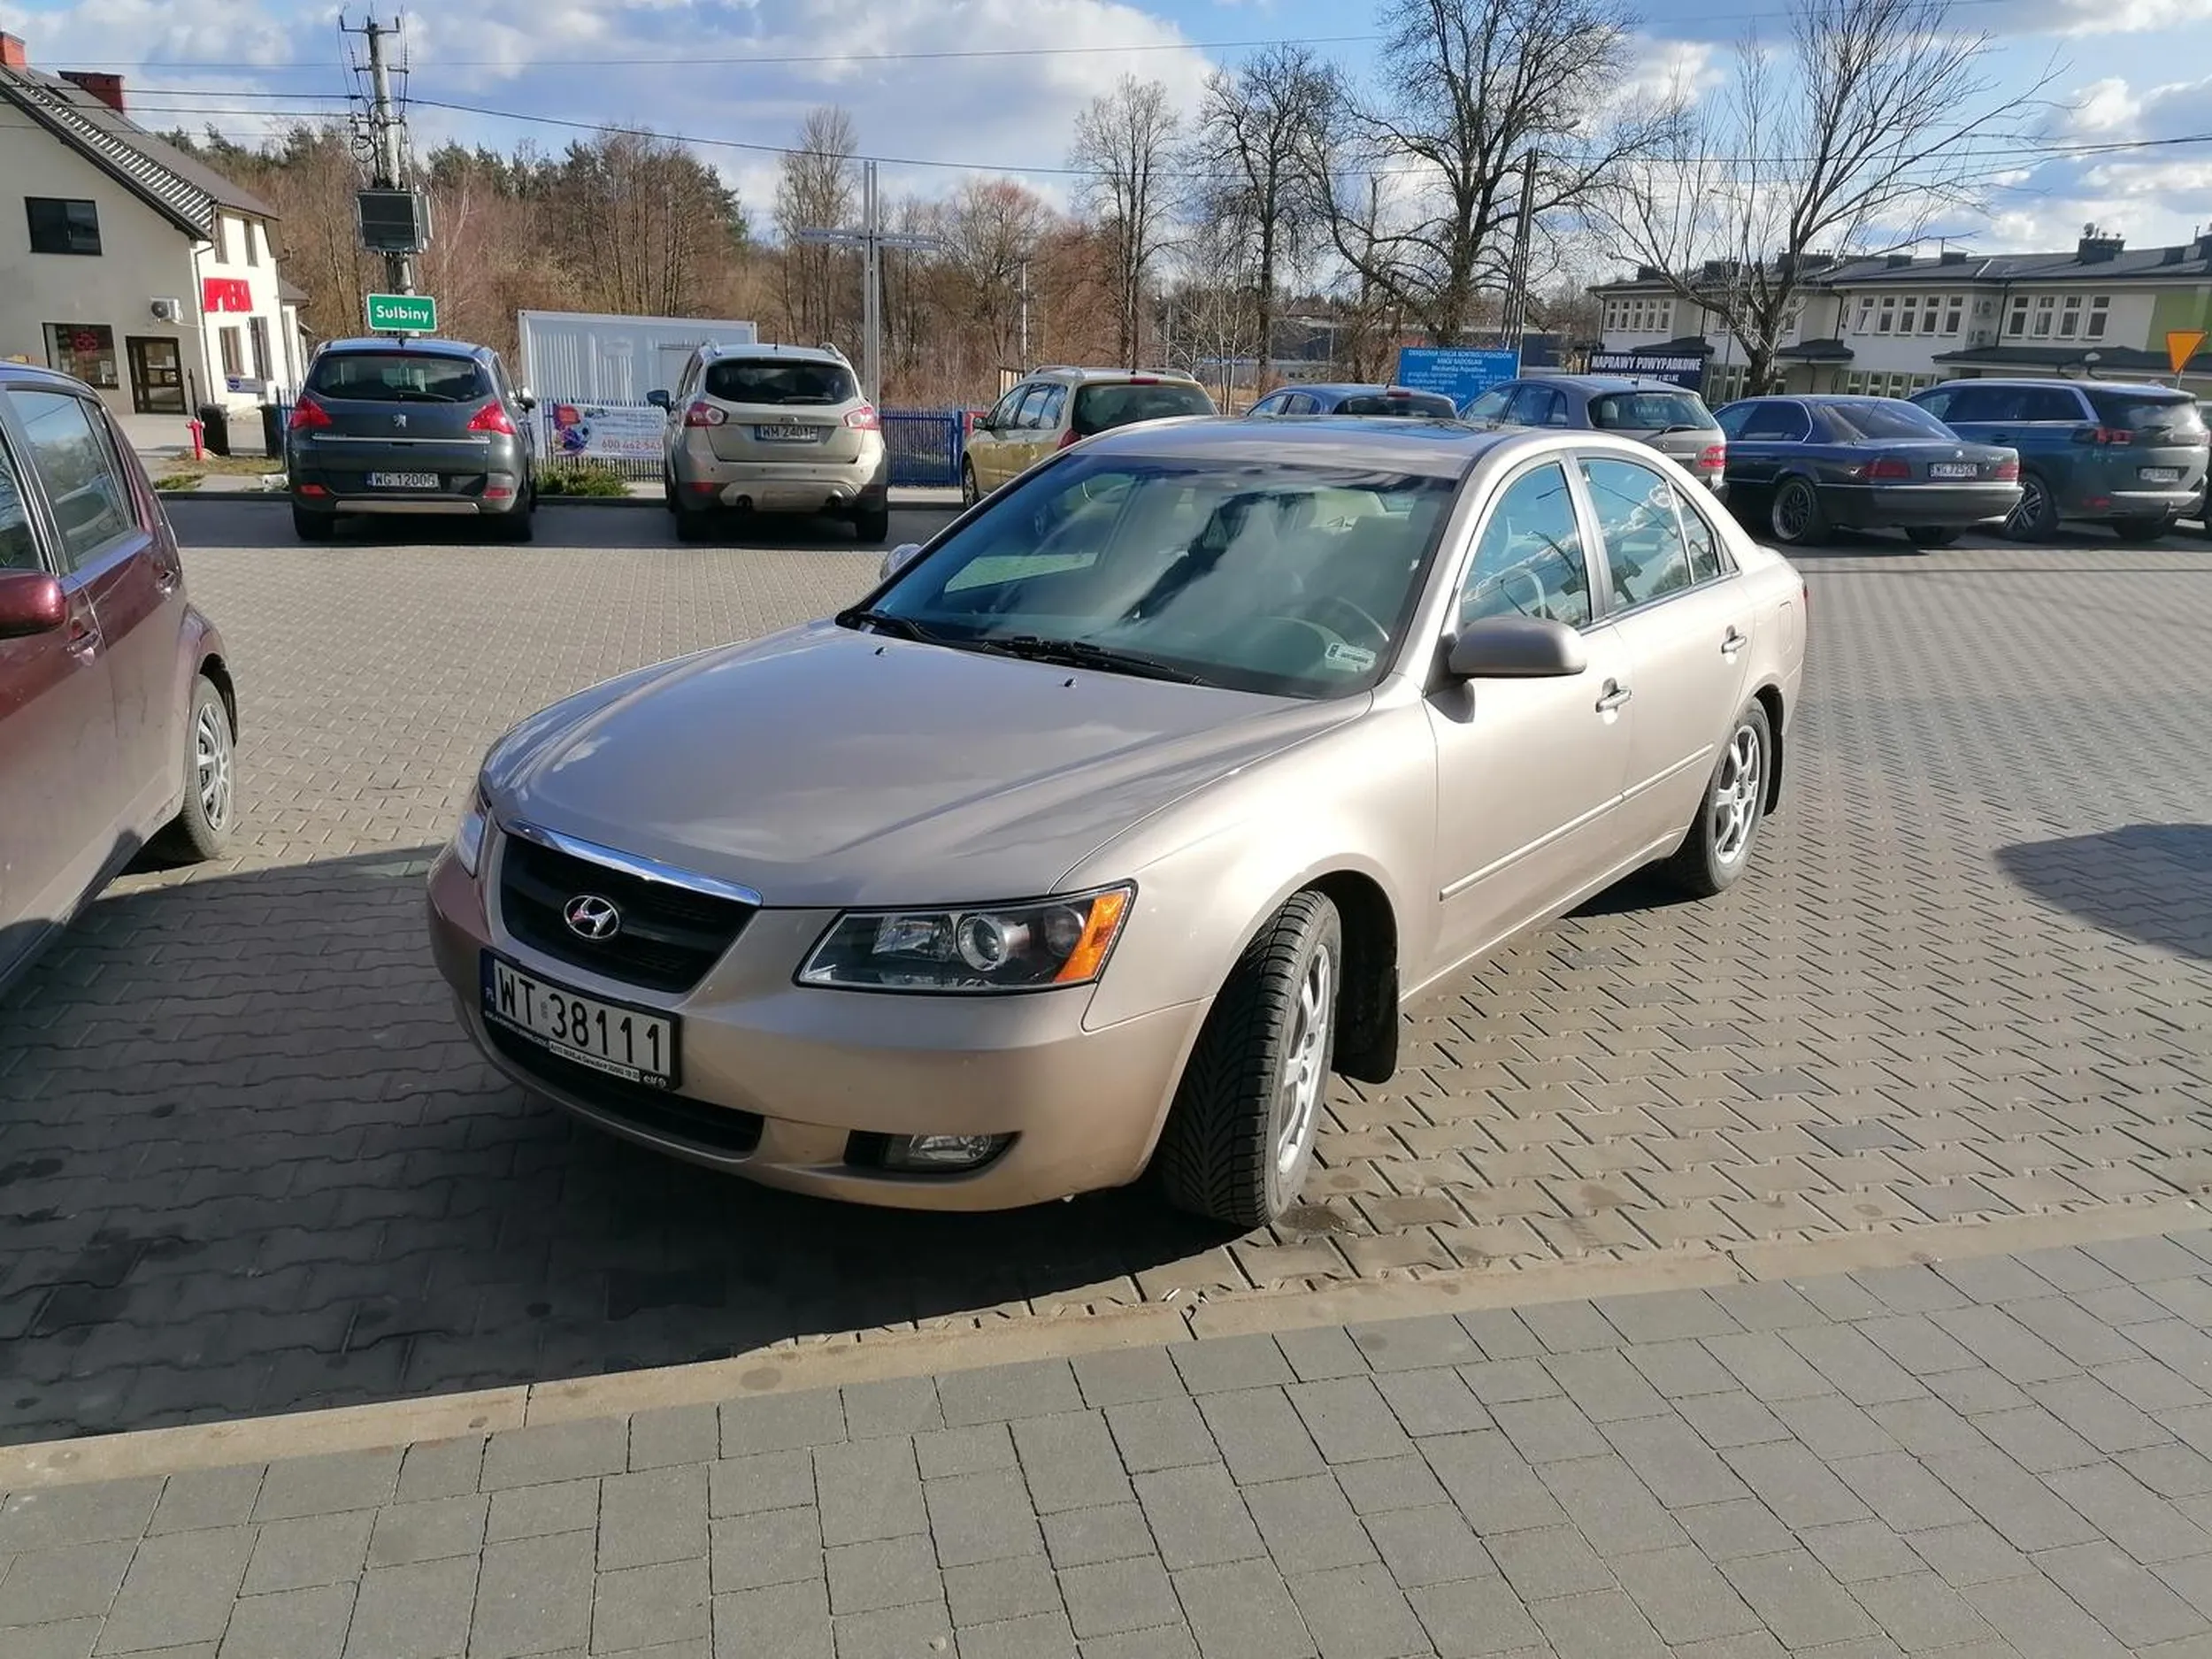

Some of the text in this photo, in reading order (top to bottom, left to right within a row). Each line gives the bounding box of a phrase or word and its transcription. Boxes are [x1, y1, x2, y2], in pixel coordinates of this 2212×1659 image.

[376, 305, 429, 324] Sulbiny
[1592, 356, 1701, 371] NAPRAWY POWYPADKOWE
[375, 473, 391, 485] WG
[499, 968, 535, 1025] WT
[549, 993, 659, 1071] 38111
